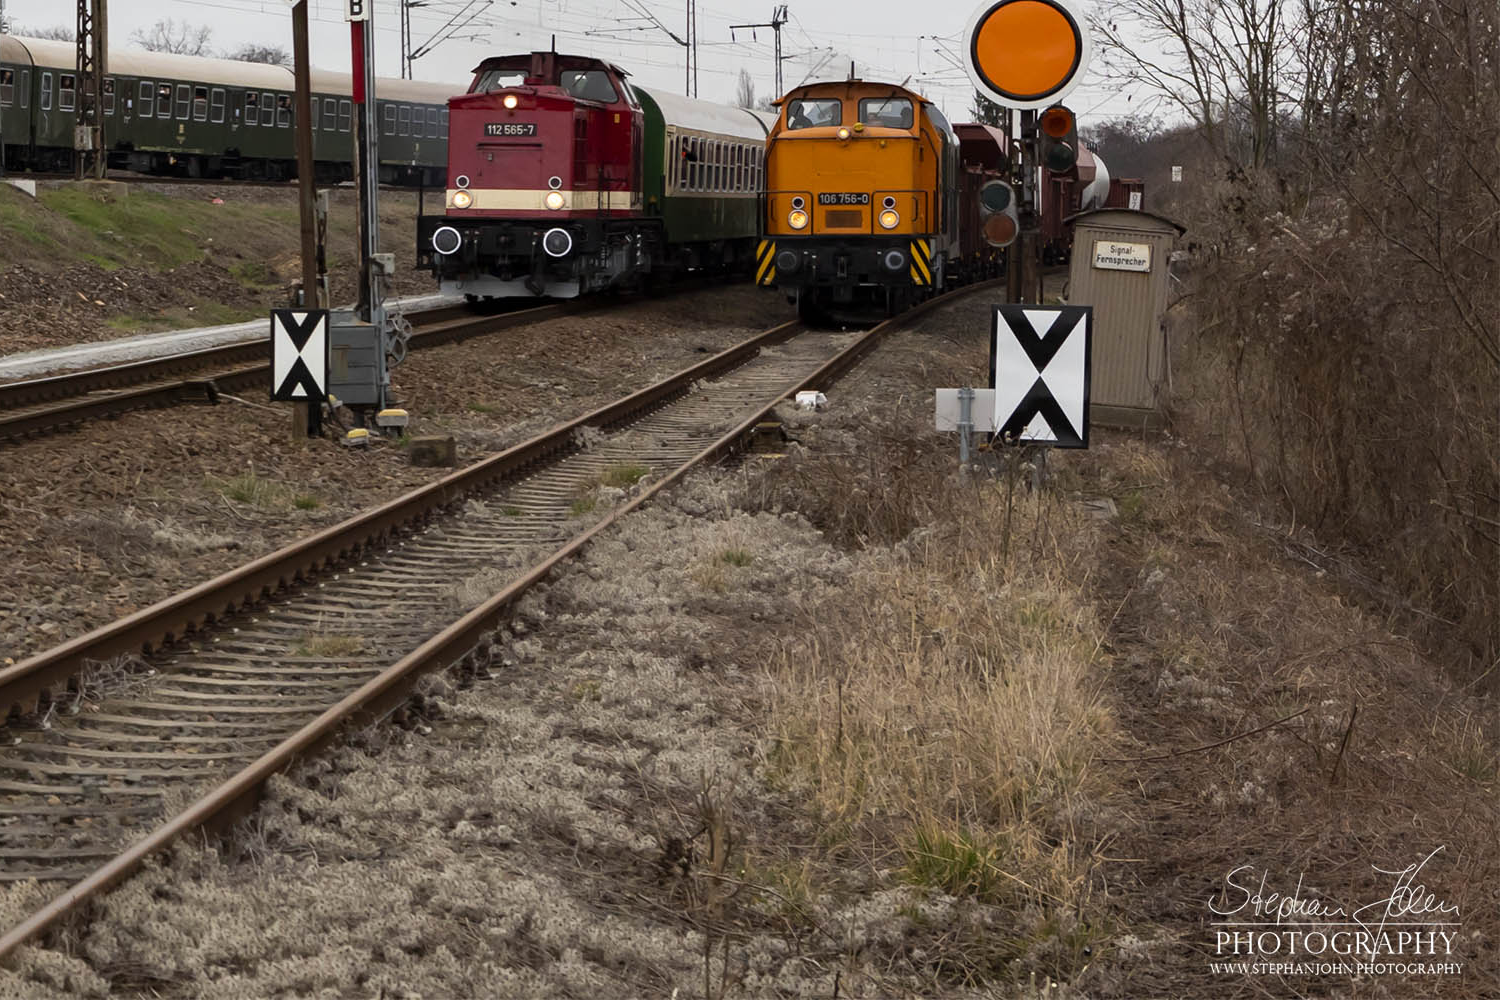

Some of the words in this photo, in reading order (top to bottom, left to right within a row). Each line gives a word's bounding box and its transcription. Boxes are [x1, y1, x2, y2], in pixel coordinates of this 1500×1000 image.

[487, 124, 503, 135] 112
[504, 124, 535, 135] 565-7
[820, 193, 837, 204] 106
[838, 193, 869, 204] 756-0
[1110, 244, 1136, 256] Signal-
[1097, 253, 1147, 266] Fernsprecher
